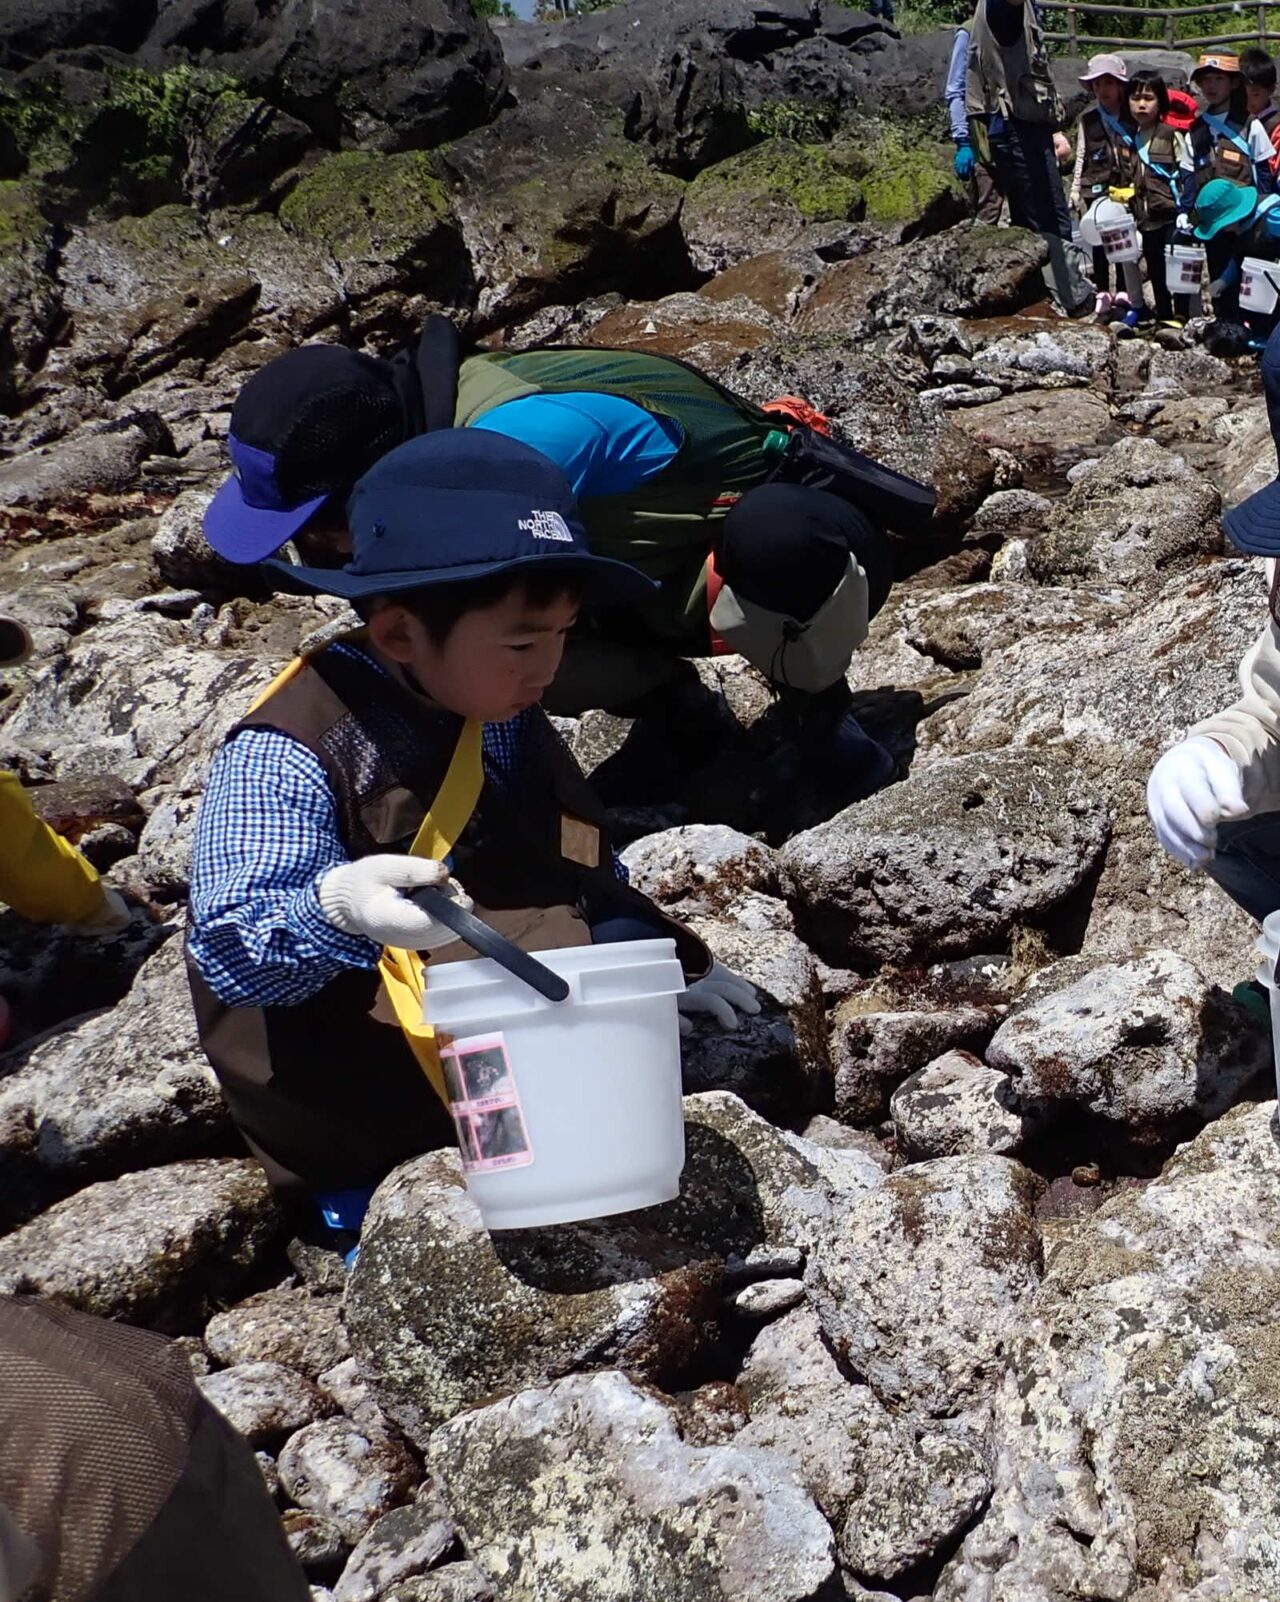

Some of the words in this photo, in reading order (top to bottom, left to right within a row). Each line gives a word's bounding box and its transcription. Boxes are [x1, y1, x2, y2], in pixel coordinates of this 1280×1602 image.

[531, 510, 554, 521] THE
[517, 519, 554, 530] NORTH
[532, 529, 559, 540] FACE
